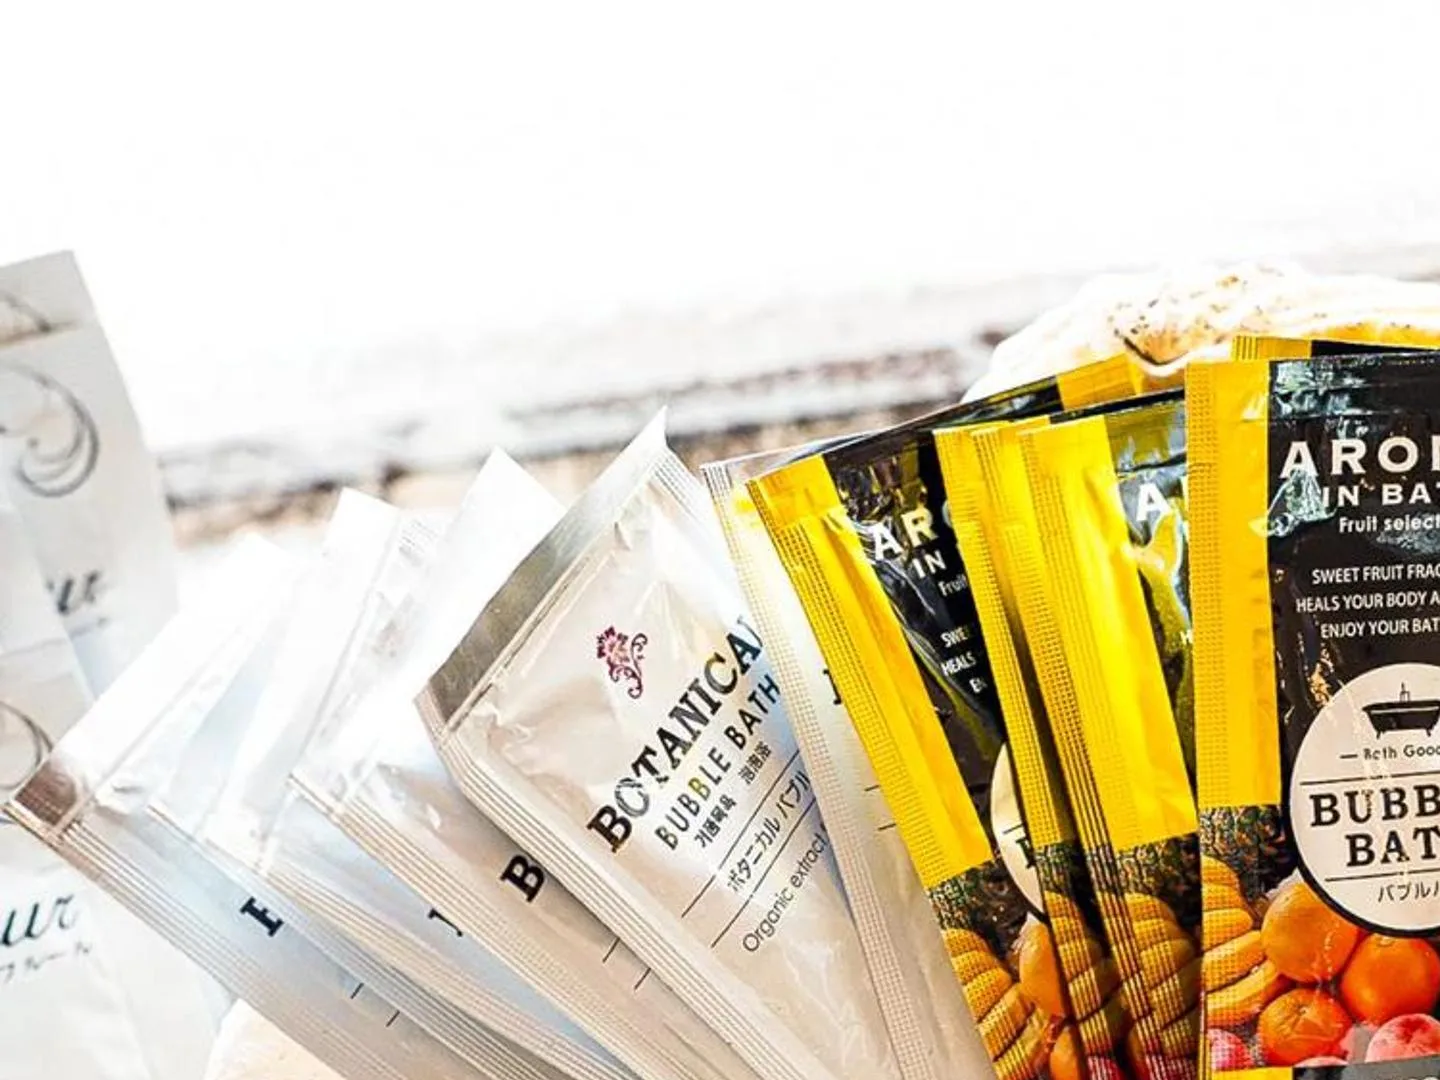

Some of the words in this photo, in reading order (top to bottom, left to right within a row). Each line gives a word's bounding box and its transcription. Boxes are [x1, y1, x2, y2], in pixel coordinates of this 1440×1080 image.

[1322, 484, 1360, 508] IN
[872, 500, 951, 561] AR
[1339, 515, 1378, 534] Fruit
[911, 549, 947, 579] IN
[1312, 566, 1360, 585] SWEET
[1362, 563, 1404, 583] FRUIT
[1296, 594, 1340, 613] HEALS
[1342, 593, 1384, 611] YOUR
[1386, 590, 1427, 609] BODY
[1320, 620, 1365, 640] ENJOY
[1367, 618, 1409, 637] YOUR
[586, 615, 764, 854] BOTANICA
[653, 747, 732, 853] BUBBLE
[724, 674, 782, 751] BATH
[742, 887, 796, 953] Organic
